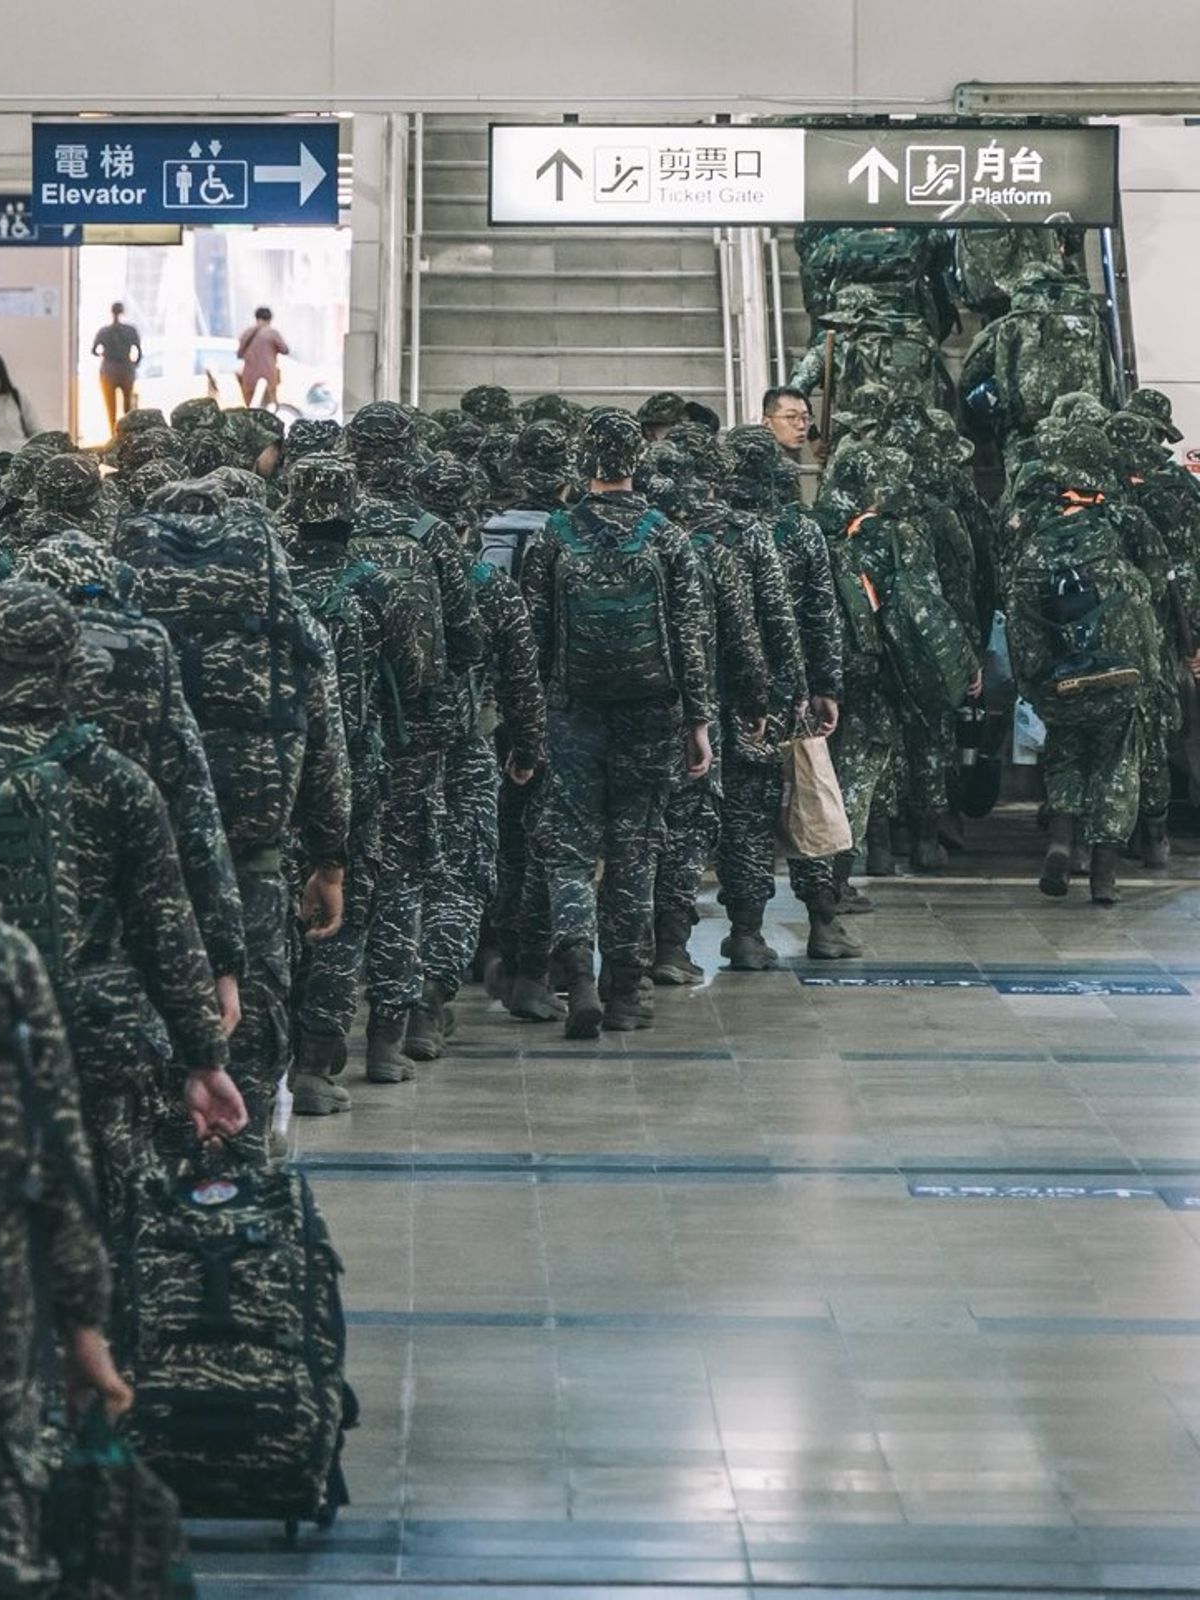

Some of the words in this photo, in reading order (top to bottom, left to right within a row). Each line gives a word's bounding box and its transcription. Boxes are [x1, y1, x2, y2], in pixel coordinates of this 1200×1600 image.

[55, 144, 134, 178] 電梯
[659, 147, 761, 180] 剪票口
[974, 144, 1043, 182] 月台
[41, 183, 147, 205] Elevator
[658, 187, 712, 203] Ticket
[719, 187, 764, 203] Gate
[971, 187, 1051, 205] Platform
